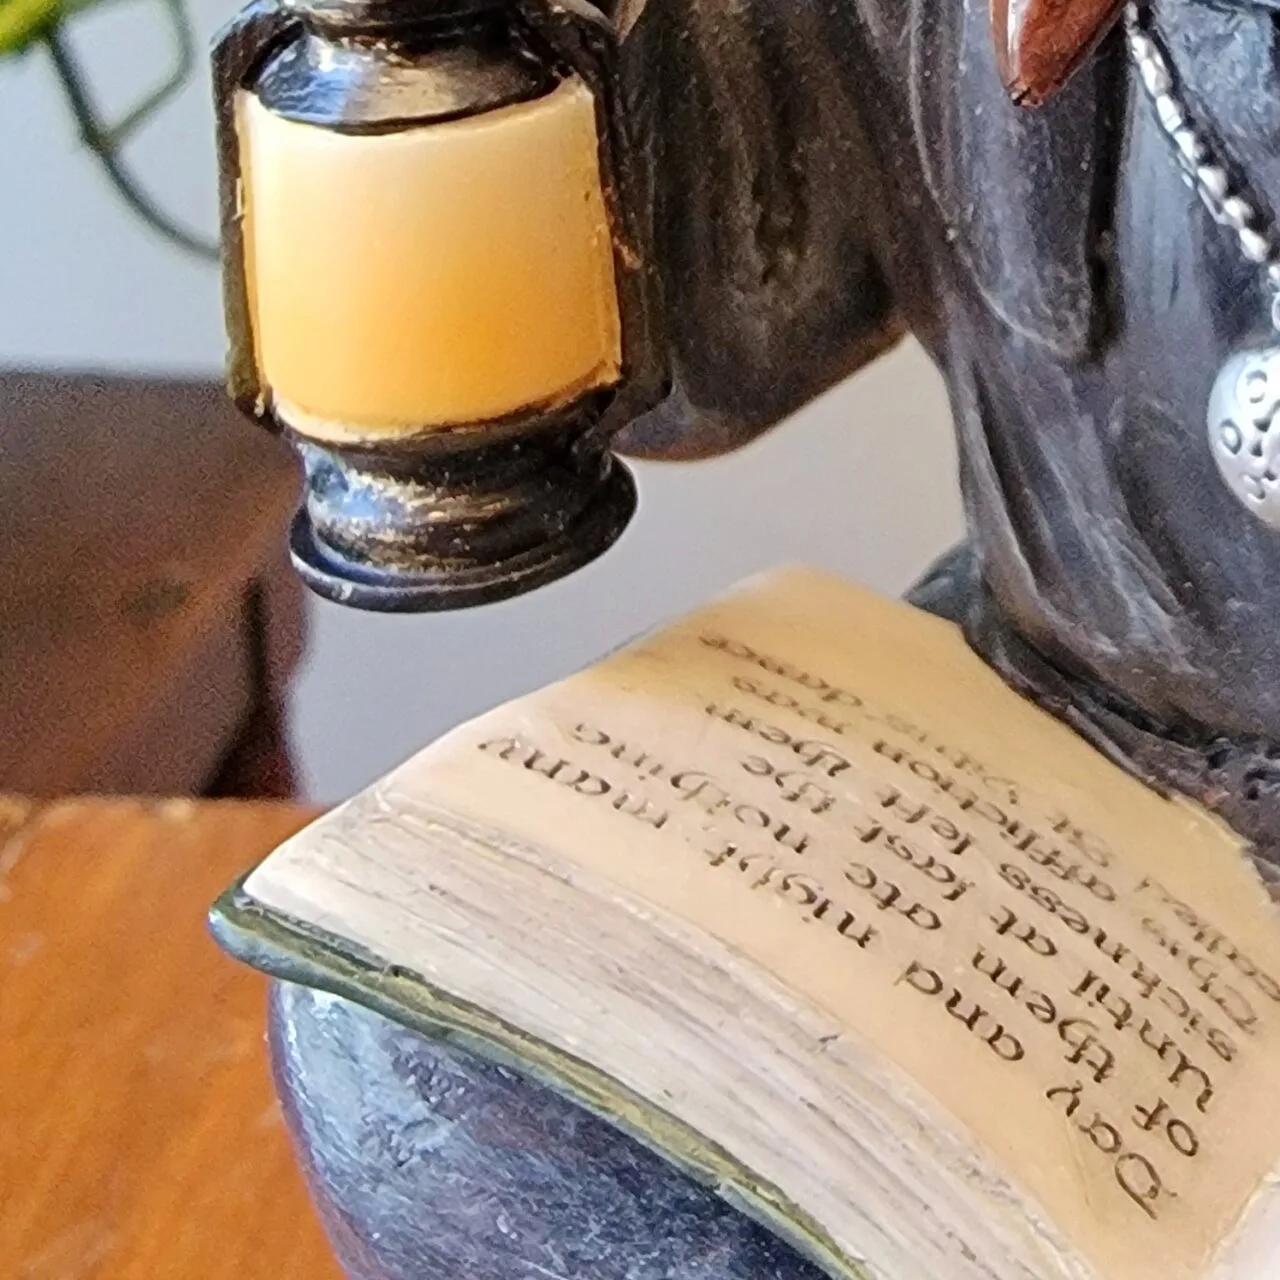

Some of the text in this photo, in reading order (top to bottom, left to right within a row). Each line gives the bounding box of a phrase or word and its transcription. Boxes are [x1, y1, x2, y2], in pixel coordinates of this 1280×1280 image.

[476, 737, 670, 830] many
[871, 739, 1118, 904] affliction
[873, 786, 978, 857] left
[1045, 813, 1113, 869] St
[569, 722, 1201, 1158] of them ate nothing
[739, 755, 1215, 1115] Until at last the
[995, 862, 1240, 1065] sickness
[1141, 917, 1259, 1037] This
[897, 959, 1026, 1063] and
[1045, 1079, 1181, 1221] Day
